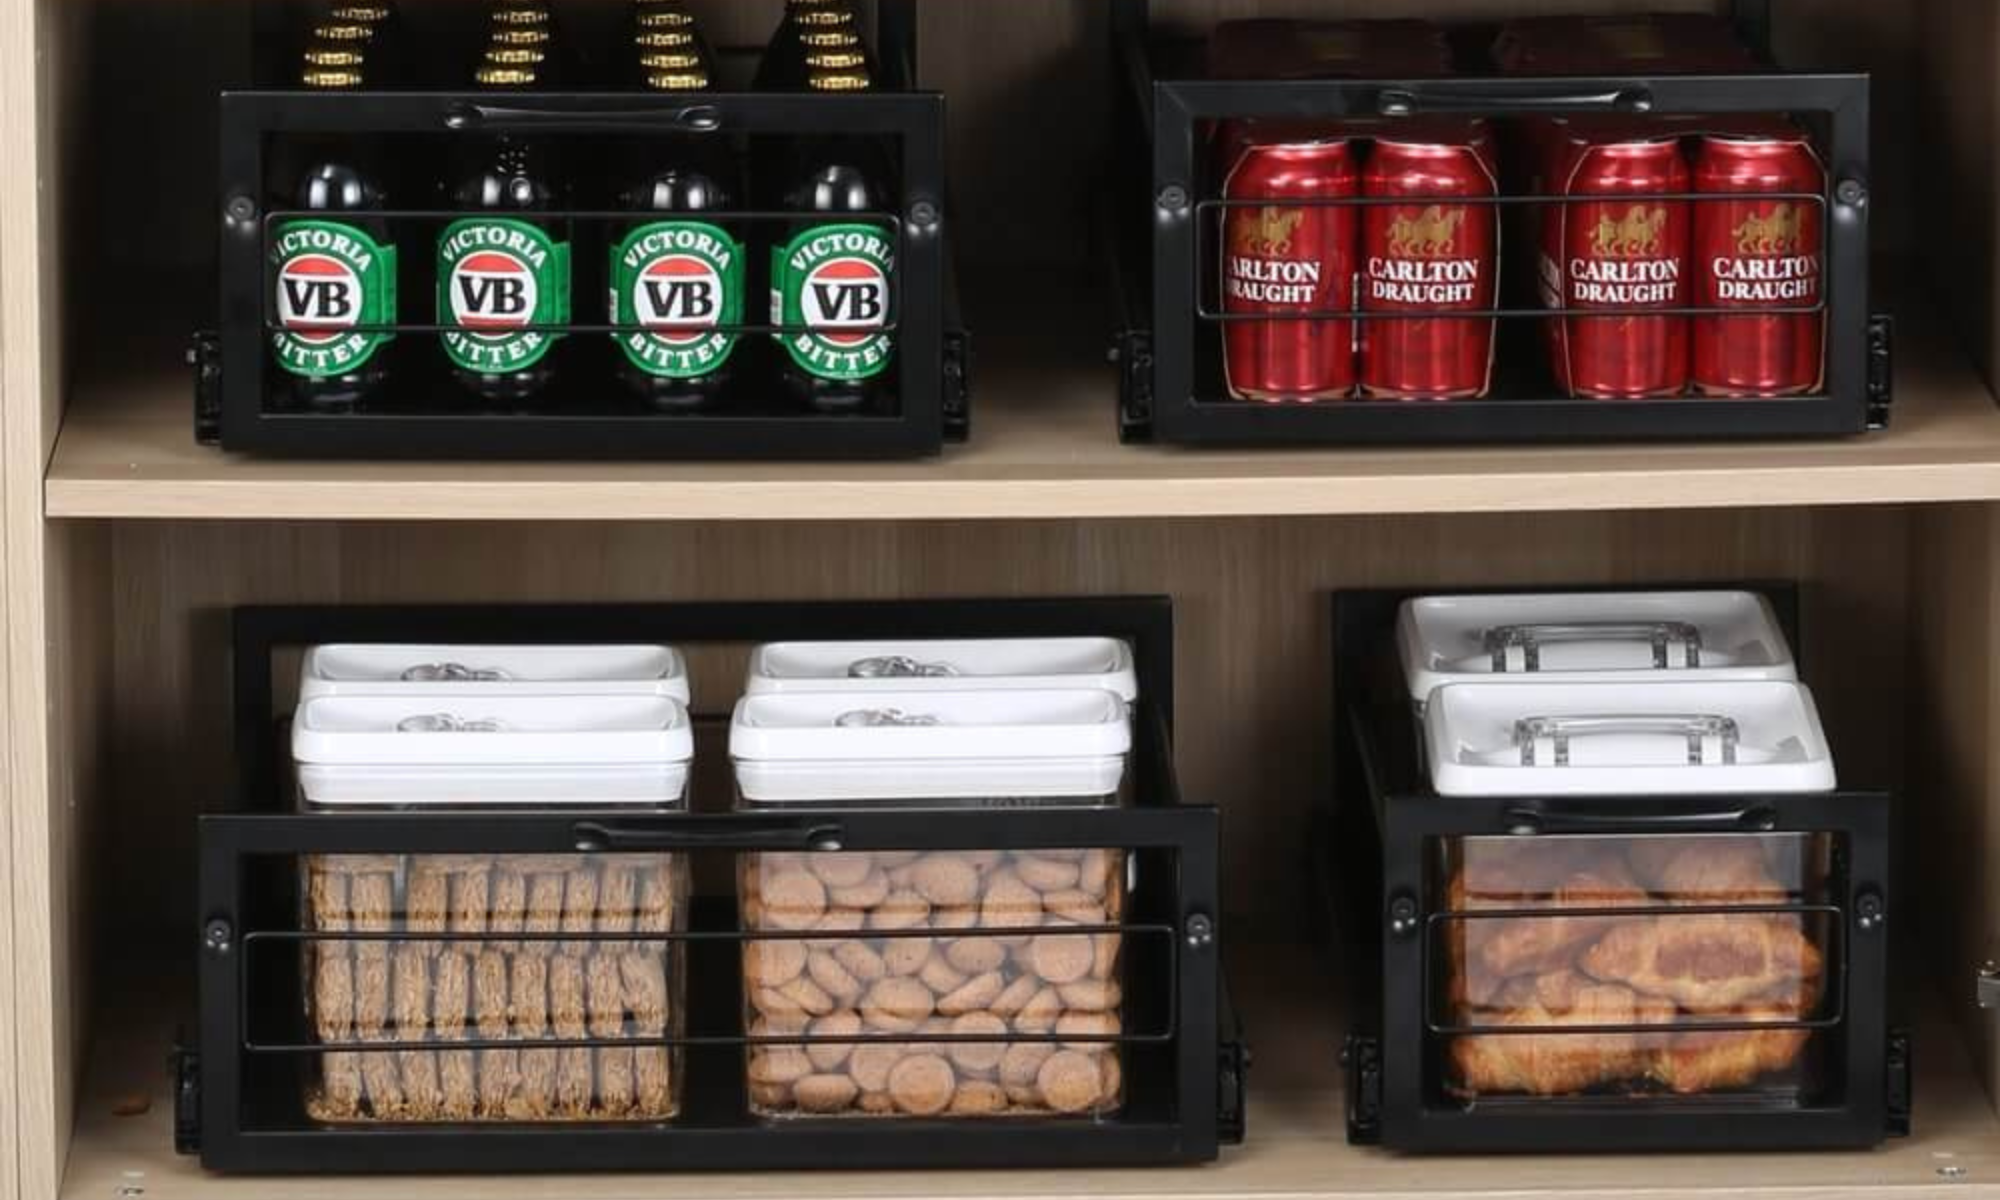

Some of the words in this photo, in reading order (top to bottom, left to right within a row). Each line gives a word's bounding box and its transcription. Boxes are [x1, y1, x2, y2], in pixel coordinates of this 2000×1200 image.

[442, 225, 547, 270] VICTORIA
[624, 229, 731, 271] VICTORIA
[1231, 255, 1321, 283] ARLTON
[1369, 256, 1479, 283] CARLTON
[1570, 257, 1680, 283] CARLTON
[283, 276, 352, 318] VB
[458, 275, 527, 315] VB
[643, 279, 714, 319] VB
[811, 282, 881, 321] VB
[1227, 279, 1317, 303] RAUGHT
[1372, 279, 1475, 303] DRAUGHT
[1574, 281, 1677, 303] DRAUGHT
[629, 332, 728, 369] BITTER
[795, 334, 892, 371] BITTER
